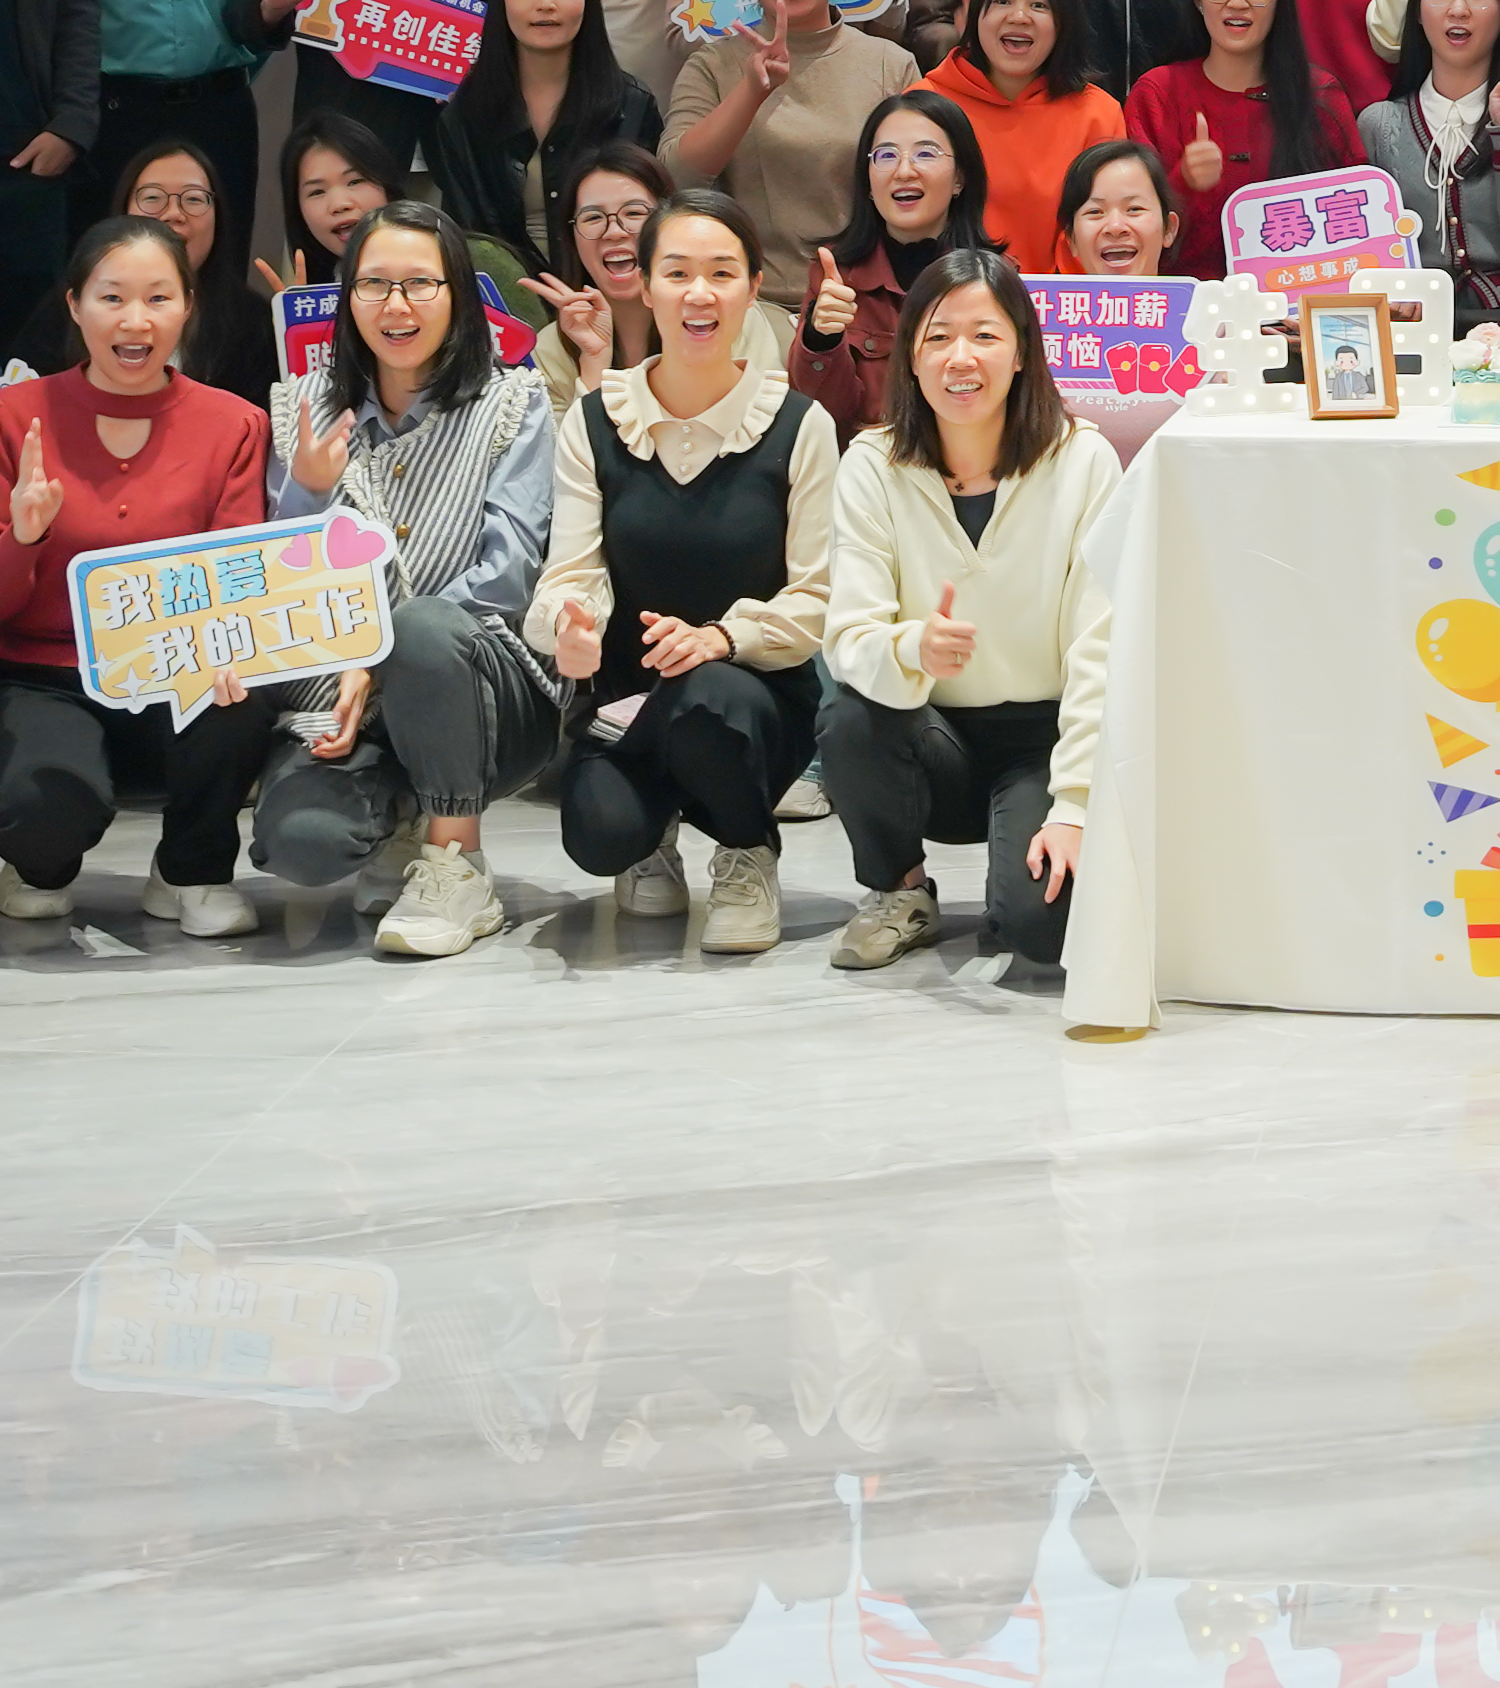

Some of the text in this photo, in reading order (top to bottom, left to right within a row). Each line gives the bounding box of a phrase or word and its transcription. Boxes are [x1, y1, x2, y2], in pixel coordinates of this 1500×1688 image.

[1260, 189, 1369, 252] 暴富
[1277, 257, 1359, 285] 心想事成
[100, 549, 268, 631] 我热爱
[145, 587, 368, 683] 我的工作
